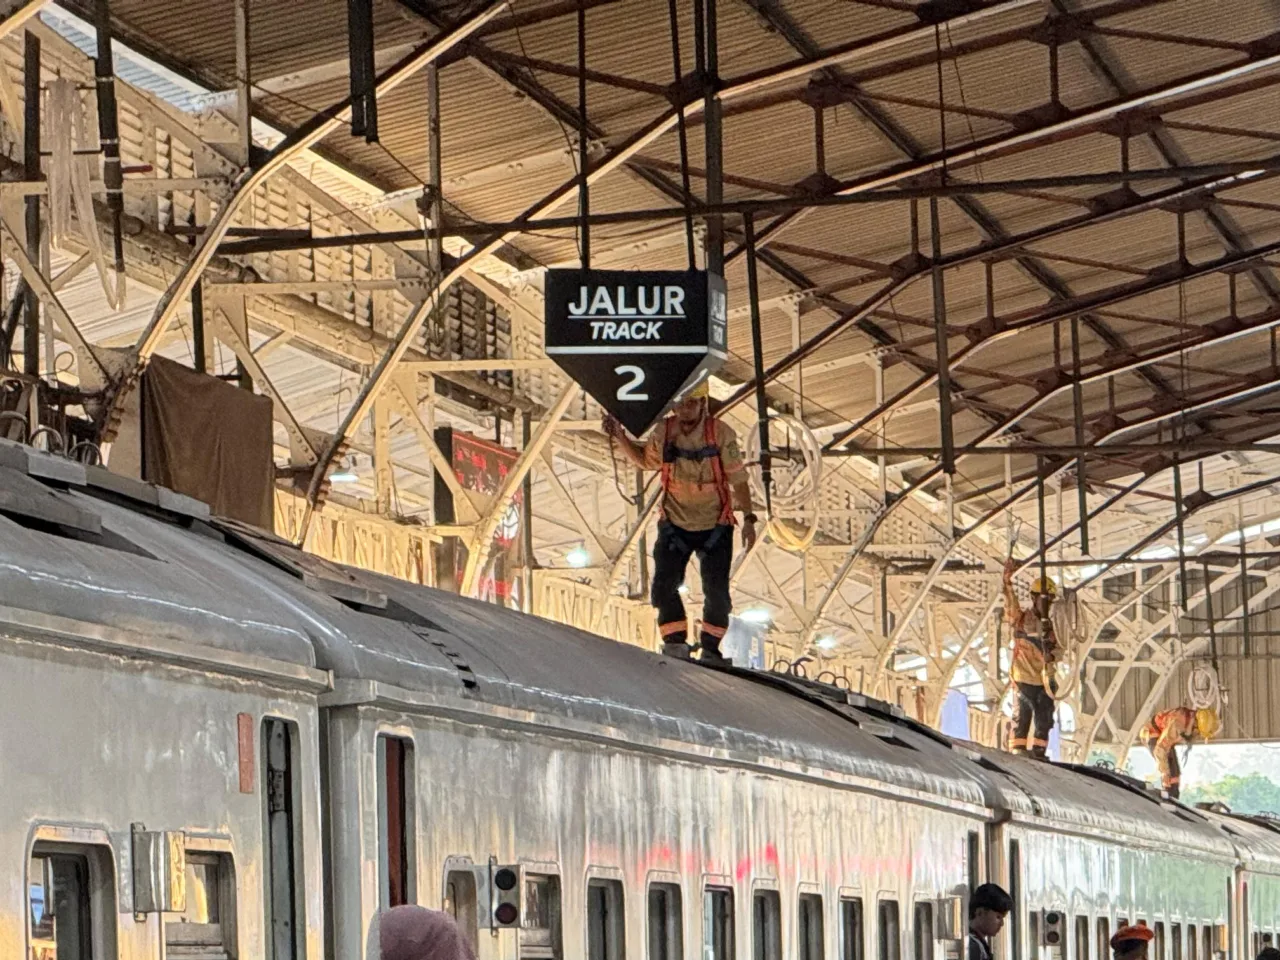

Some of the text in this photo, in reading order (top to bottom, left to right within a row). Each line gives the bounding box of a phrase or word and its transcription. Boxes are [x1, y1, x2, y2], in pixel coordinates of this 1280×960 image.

[568, 285, 686, 315] JALUR
[590, 321, 663, 340] TRACK
[614, 365, 649, 401] 2
